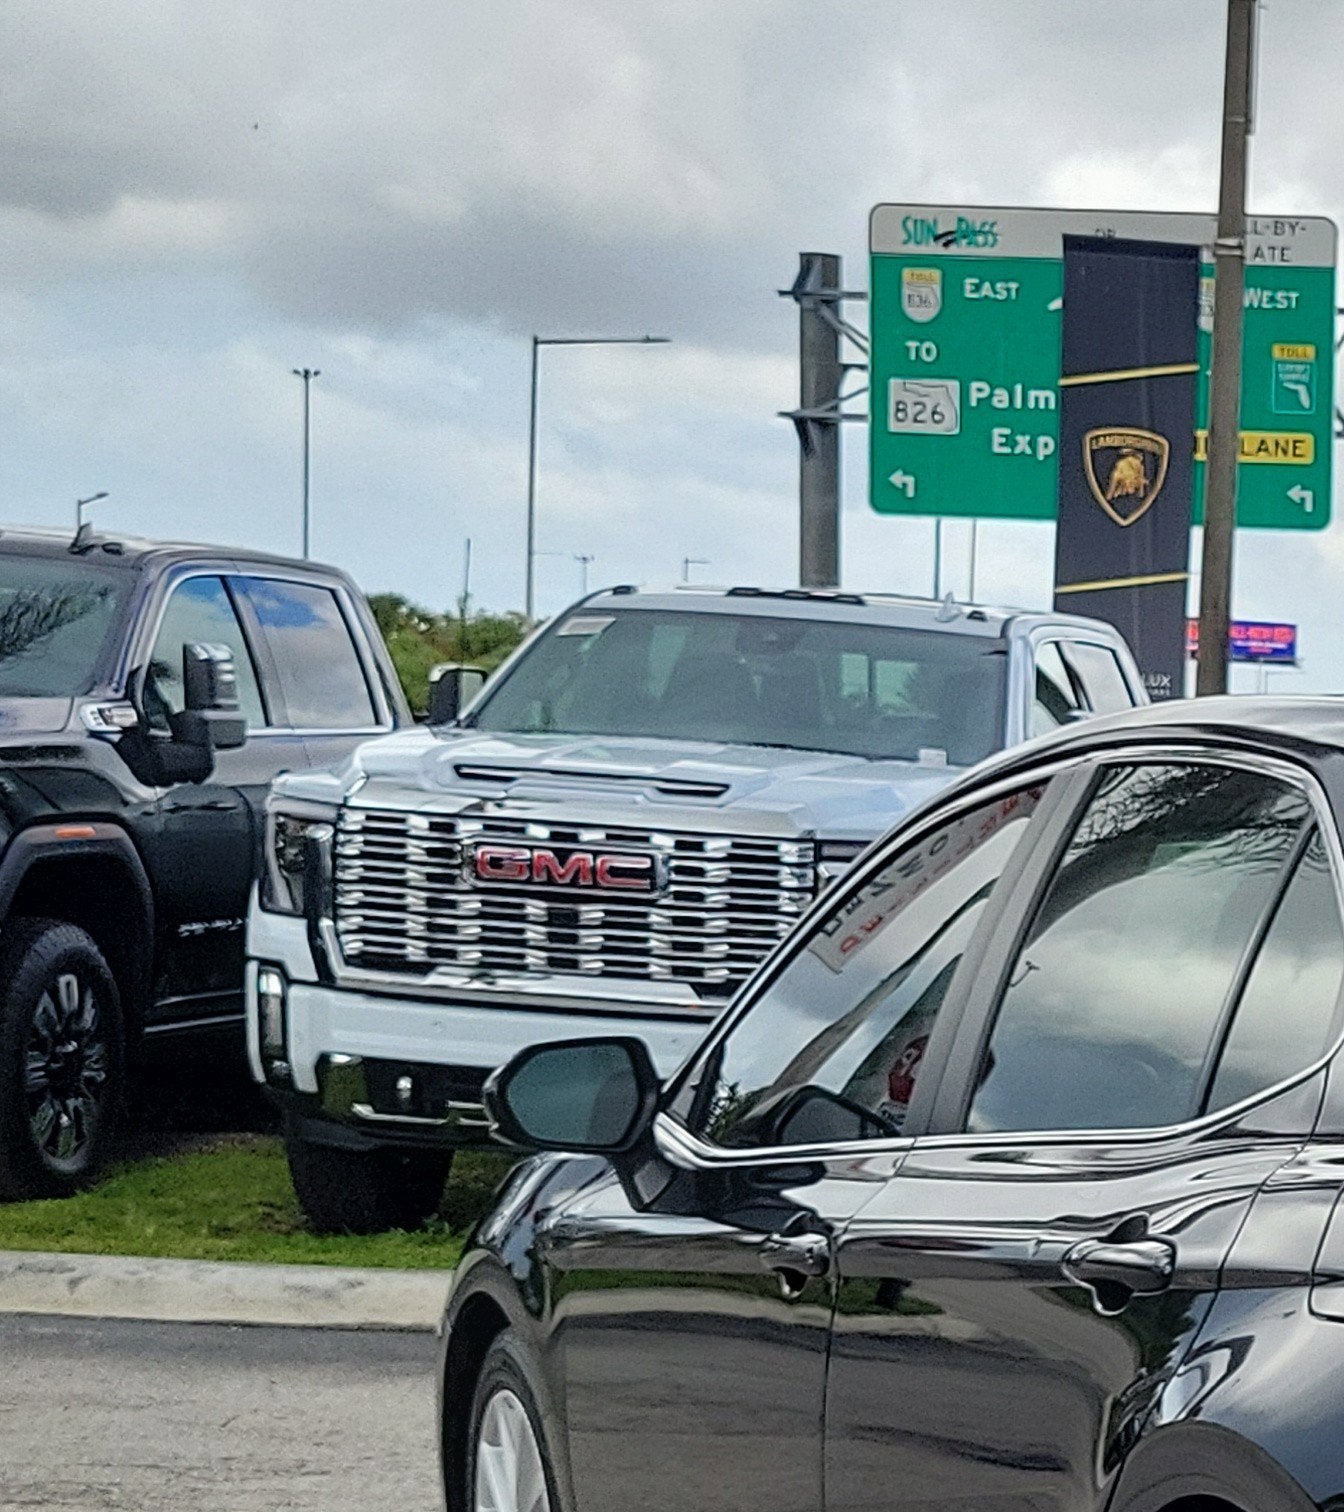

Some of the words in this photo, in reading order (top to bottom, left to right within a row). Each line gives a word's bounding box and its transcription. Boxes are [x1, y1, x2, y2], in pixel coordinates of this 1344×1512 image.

[902, 216, 937, 244] SUN
[963, 278, 1019, 299] EAST
[1243, 288, 1299, 309] WEST
[905, 341, 937, 361] TO
[969, 381, 1056, 409] Palm
[894, 402, 946, 424] 826
[991, 427, 1055, 460] Exp
[1239, 439, 1306, 458] LANE
[476, 845, 652, 889] GMC
